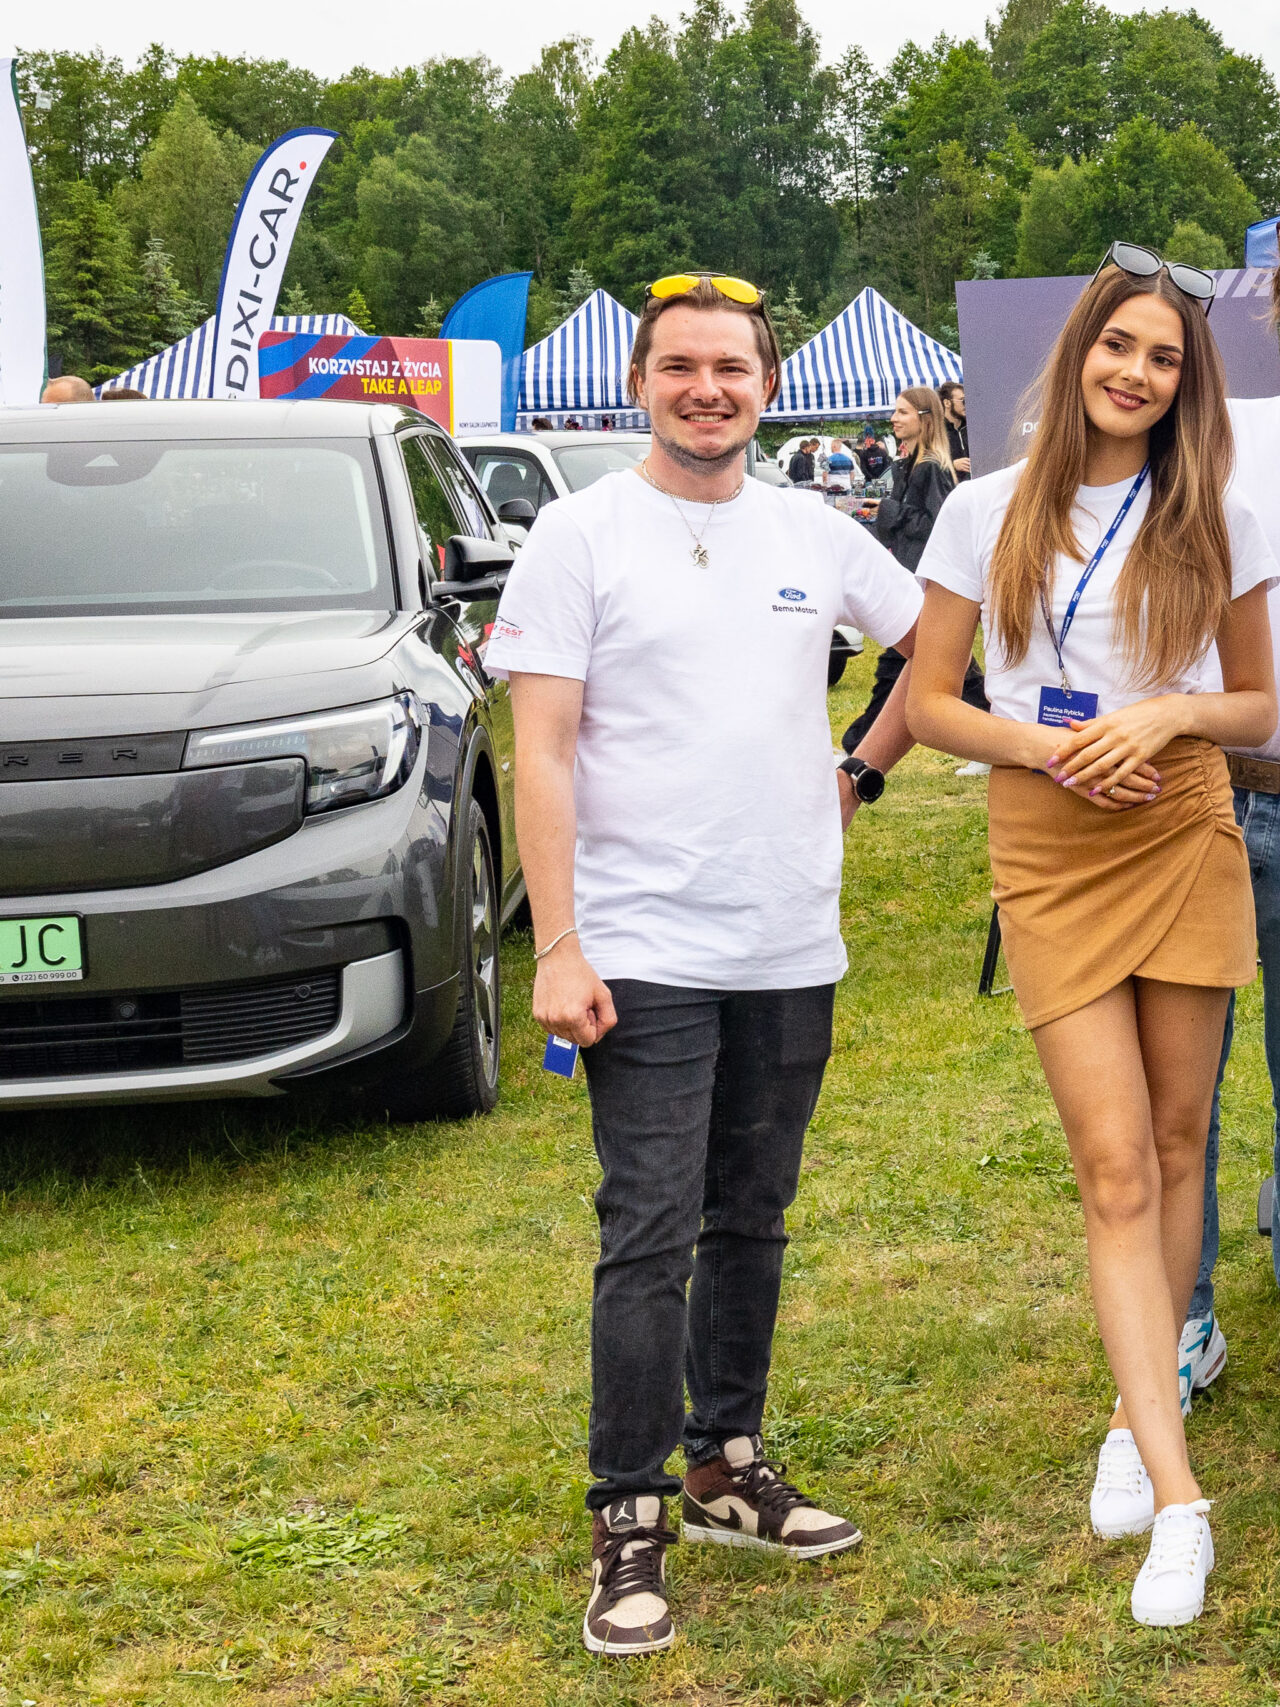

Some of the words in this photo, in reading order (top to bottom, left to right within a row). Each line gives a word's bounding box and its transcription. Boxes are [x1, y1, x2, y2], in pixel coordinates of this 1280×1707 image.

[309, 357, 388, 376] KORZYSTAJ
[391, 360, 400, 377] Z
[403, 357, 442, 378] ŻYCIA
[361, 378, 395, 394] TAKE
[397, 379, 410, 394] A
[411, 380, 442, 396] LEAP
[783, 589, 803, 600] Ford
[772, 605, 795, 613] Bemo
[795, 606, 818, 615] Motors
[1043, 705, 1063, 714] Paulina
[11, 923, 67, 968] JC
